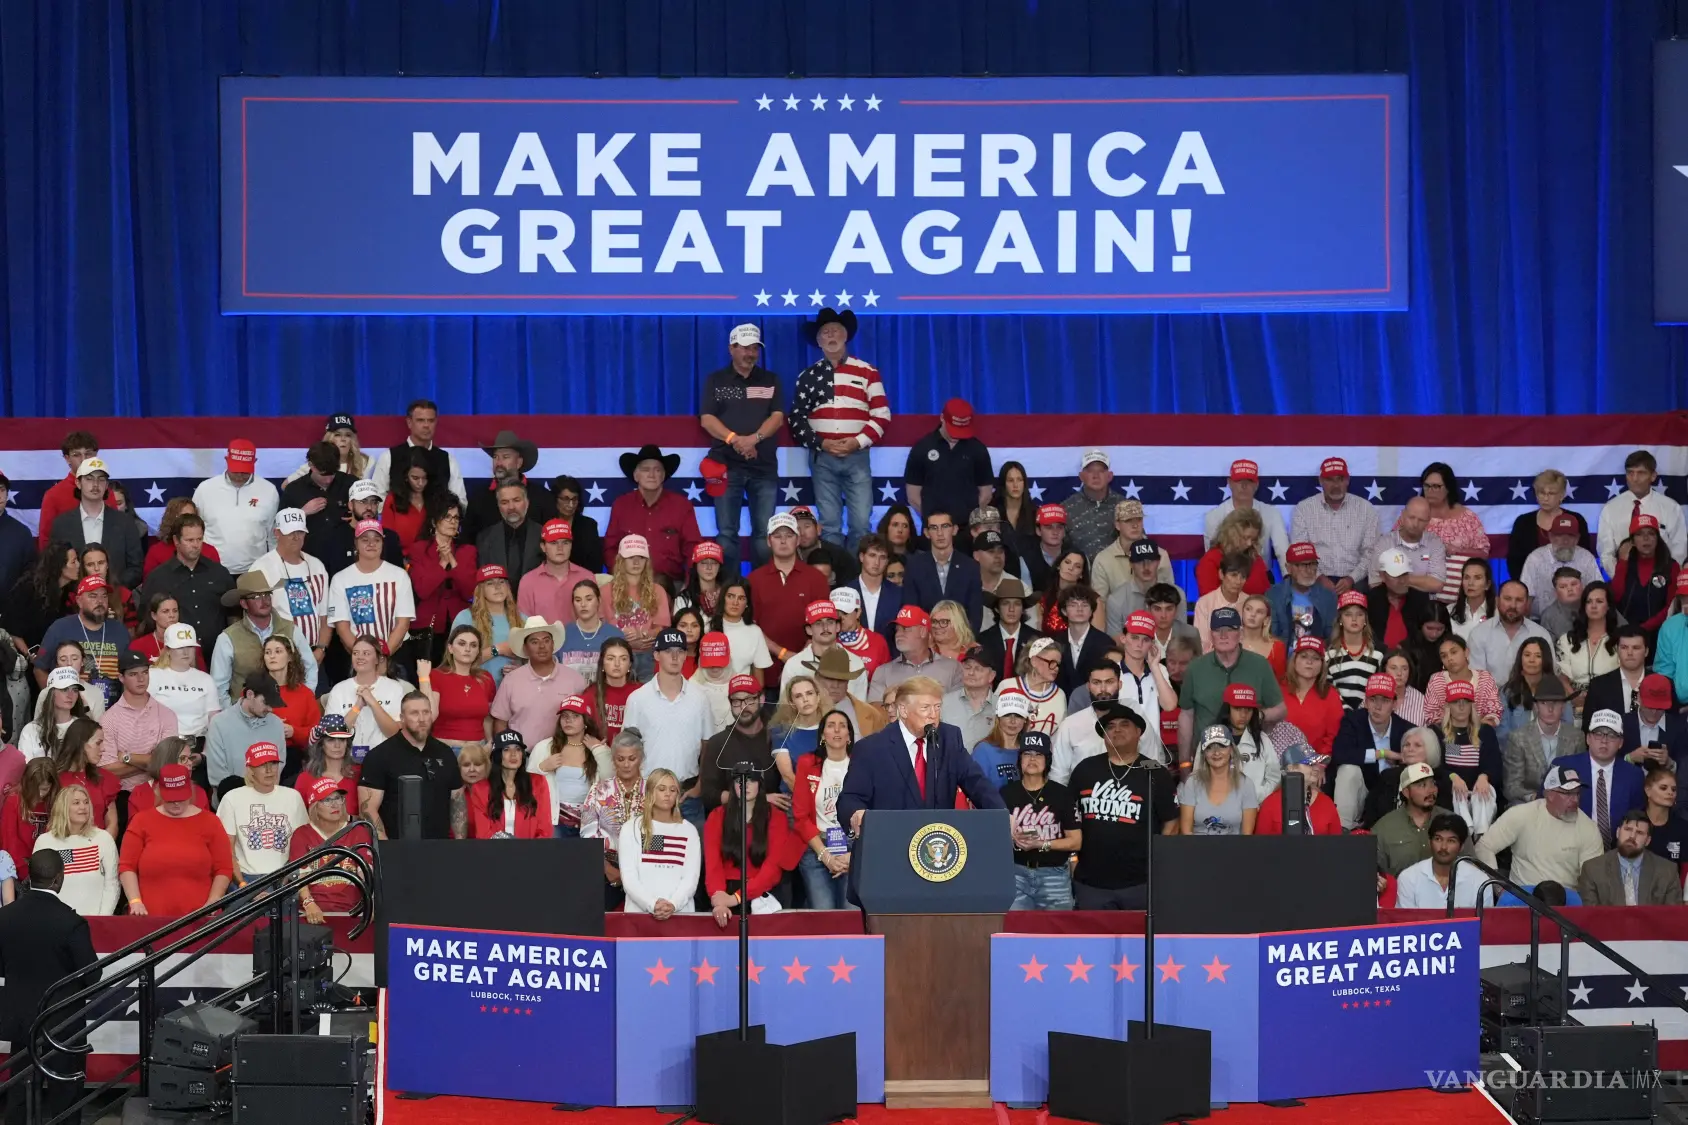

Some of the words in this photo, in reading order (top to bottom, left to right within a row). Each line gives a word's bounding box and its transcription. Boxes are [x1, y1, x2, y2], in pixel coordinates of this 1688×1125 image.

[412, 131, 702, 197] MAKE
[747, 131, 1226, 197] AMERICA
[440, 208, 782, 275] GREAT
[825, 208, 1192, 274] AGAIN!
[334, 416, 351, 425] USA
[88, 460, 103, 468] 47
[283, 513, 304, 523] USA
[1135, 545, 1154, 554] USA
[177, 630, 193, 640] CK
[664, 633, 683, 643] USA
[90, 641, 117, 651] YEARS
[342, 699, 391, 709] FROM
[500, 732, 520, 742] USA
[1025, 736, 1043, 746] USA
[1090, 778, 1133, 803] Viva
[1013, 803, 1056, 826] Viva
[1081, 797, 1142, 820] TRUMP!
[911, 825, 936, 851] PRESIDENT
[952, 832, 965, 855] UNITED
[406, 937, 478, 960] MAKE
[487, 943, 608, 969] AMERICA
[1268, 940, 1338, 963] MAKE
[1348, 931, 1462, 958] AMERICA
[413, 961, 498, 985] GREAT
[507, 968, 600, 992] AGAIN!
[1276, 962, 1359, 987] GREAT
[1367, 955, 1456, 980] AGAIN!
[1332, 986, 1373, 997] LUBBOCK,
[1375, 984, 1401, 993] TEXAS
[470, 991, 512, 1001] LUBBOCK,
[515, 993, 542, 1003] TEXAS
